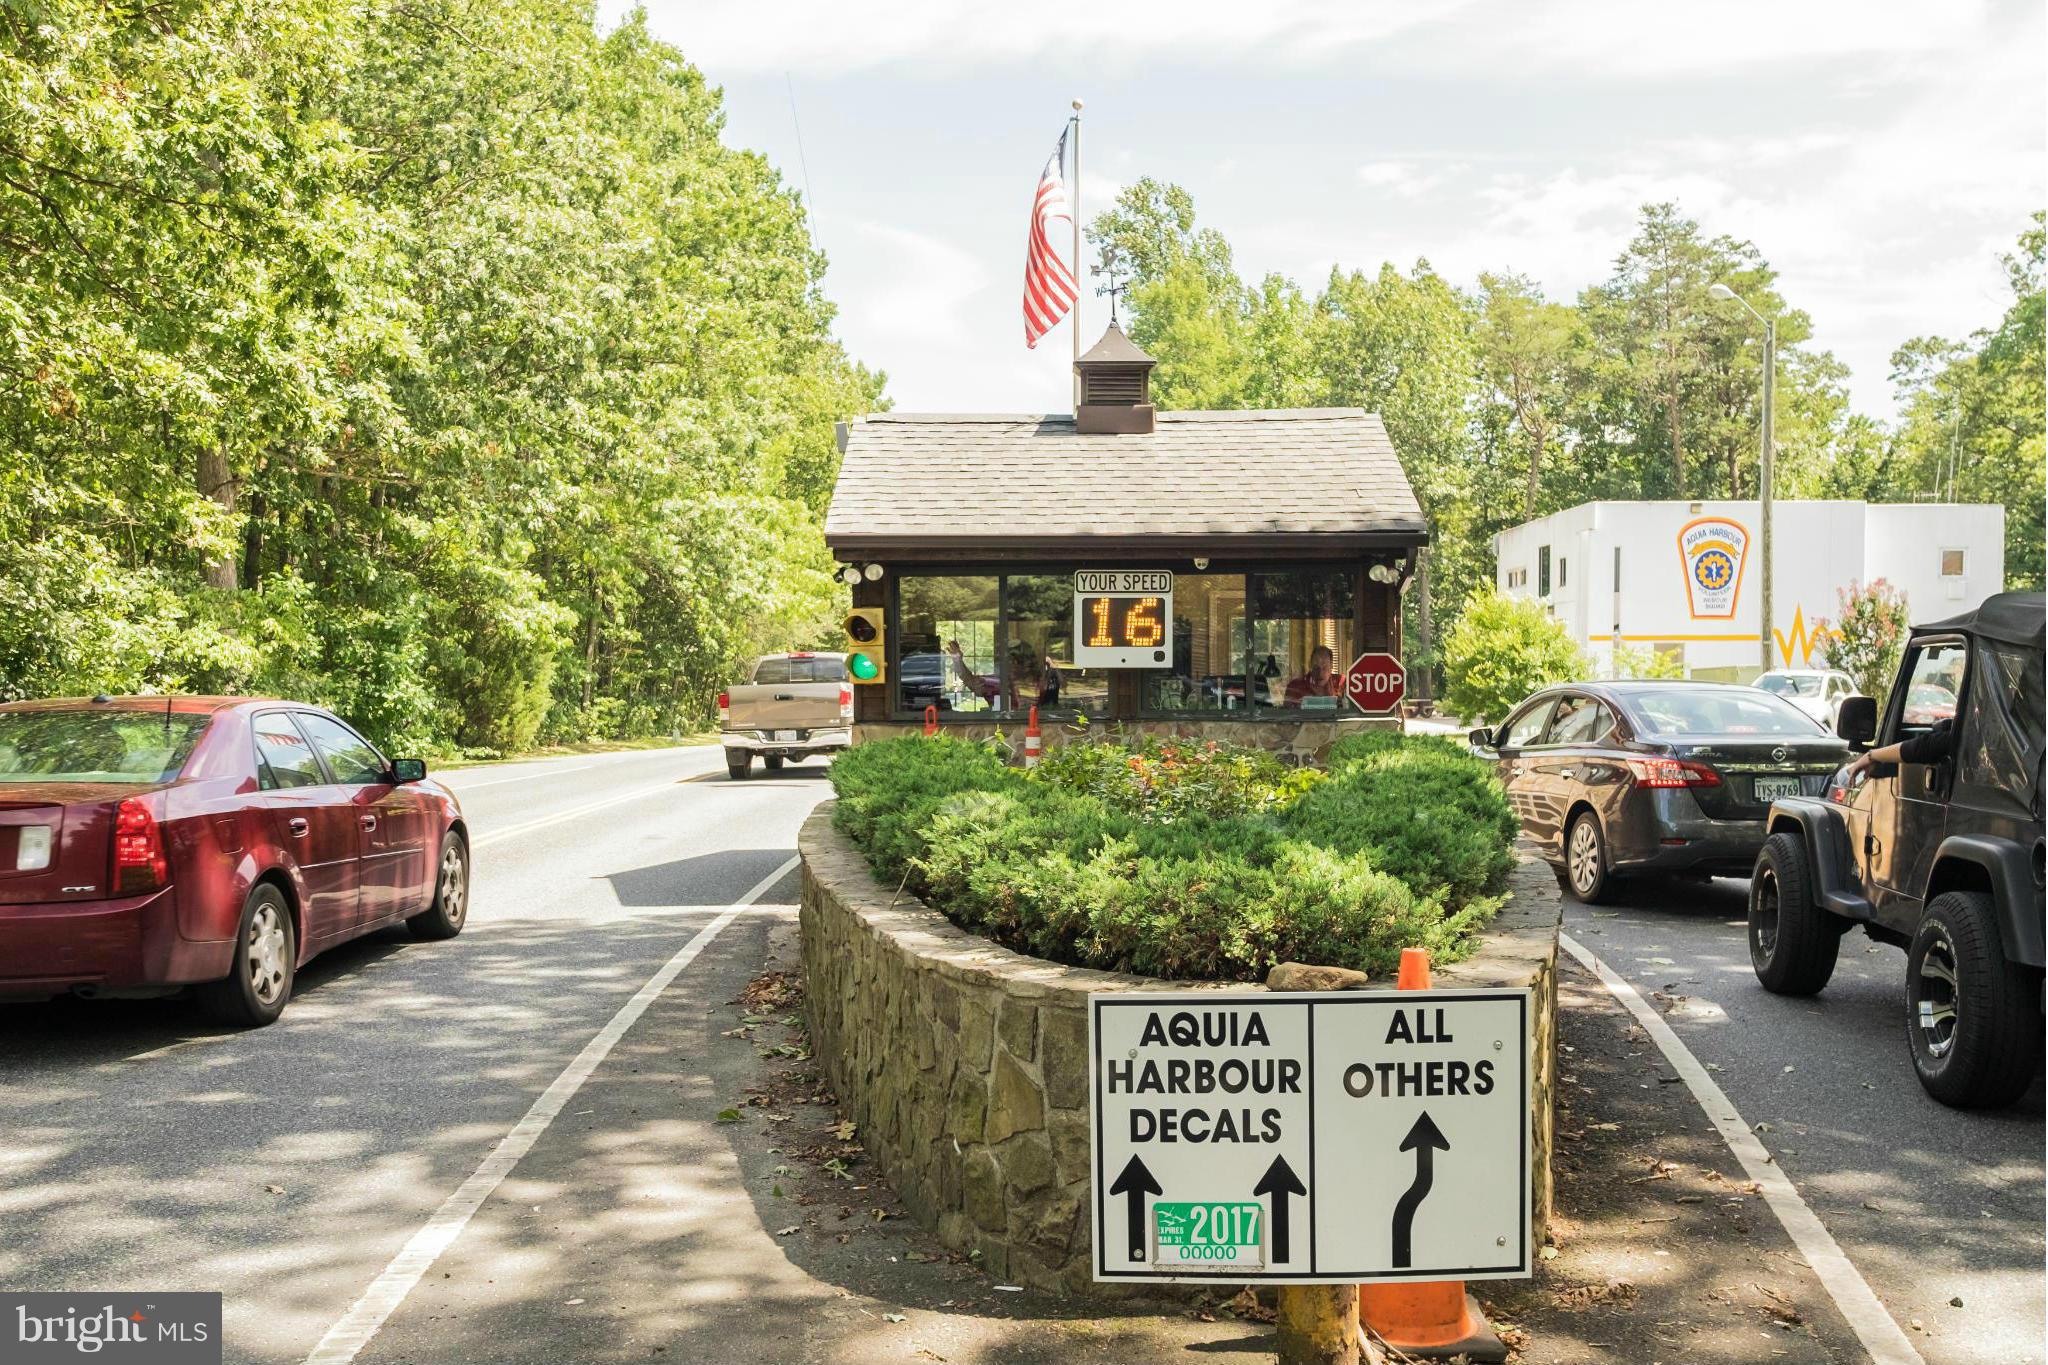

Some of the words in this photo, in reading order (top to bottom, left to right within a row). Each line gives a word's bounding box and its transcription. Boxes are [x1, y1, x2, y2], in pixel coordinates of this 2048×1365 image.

[1687, 528, 1707, 545] AQUIA
[1709, 527, 1742, 548] HARBOUR
[1080, 574, 1117, 590] YOUR
[1123, 574, 1168, 590] SPEED
[1090, 597, 1162, 646] 16
[1349, 672, 1403, 693] STOP
[1139, 1011, 1271, 1047] AQUIA
[1384, 1008, 1454, 1044] ALL
[1108, 1058, 1302, 1095] HARBOUR
[1342, 1059, 1495, 1098] OTHERS
[1129, 1107, 1282, 1144] DECALS
[1190, 1205, 1259, 1244] 2017
